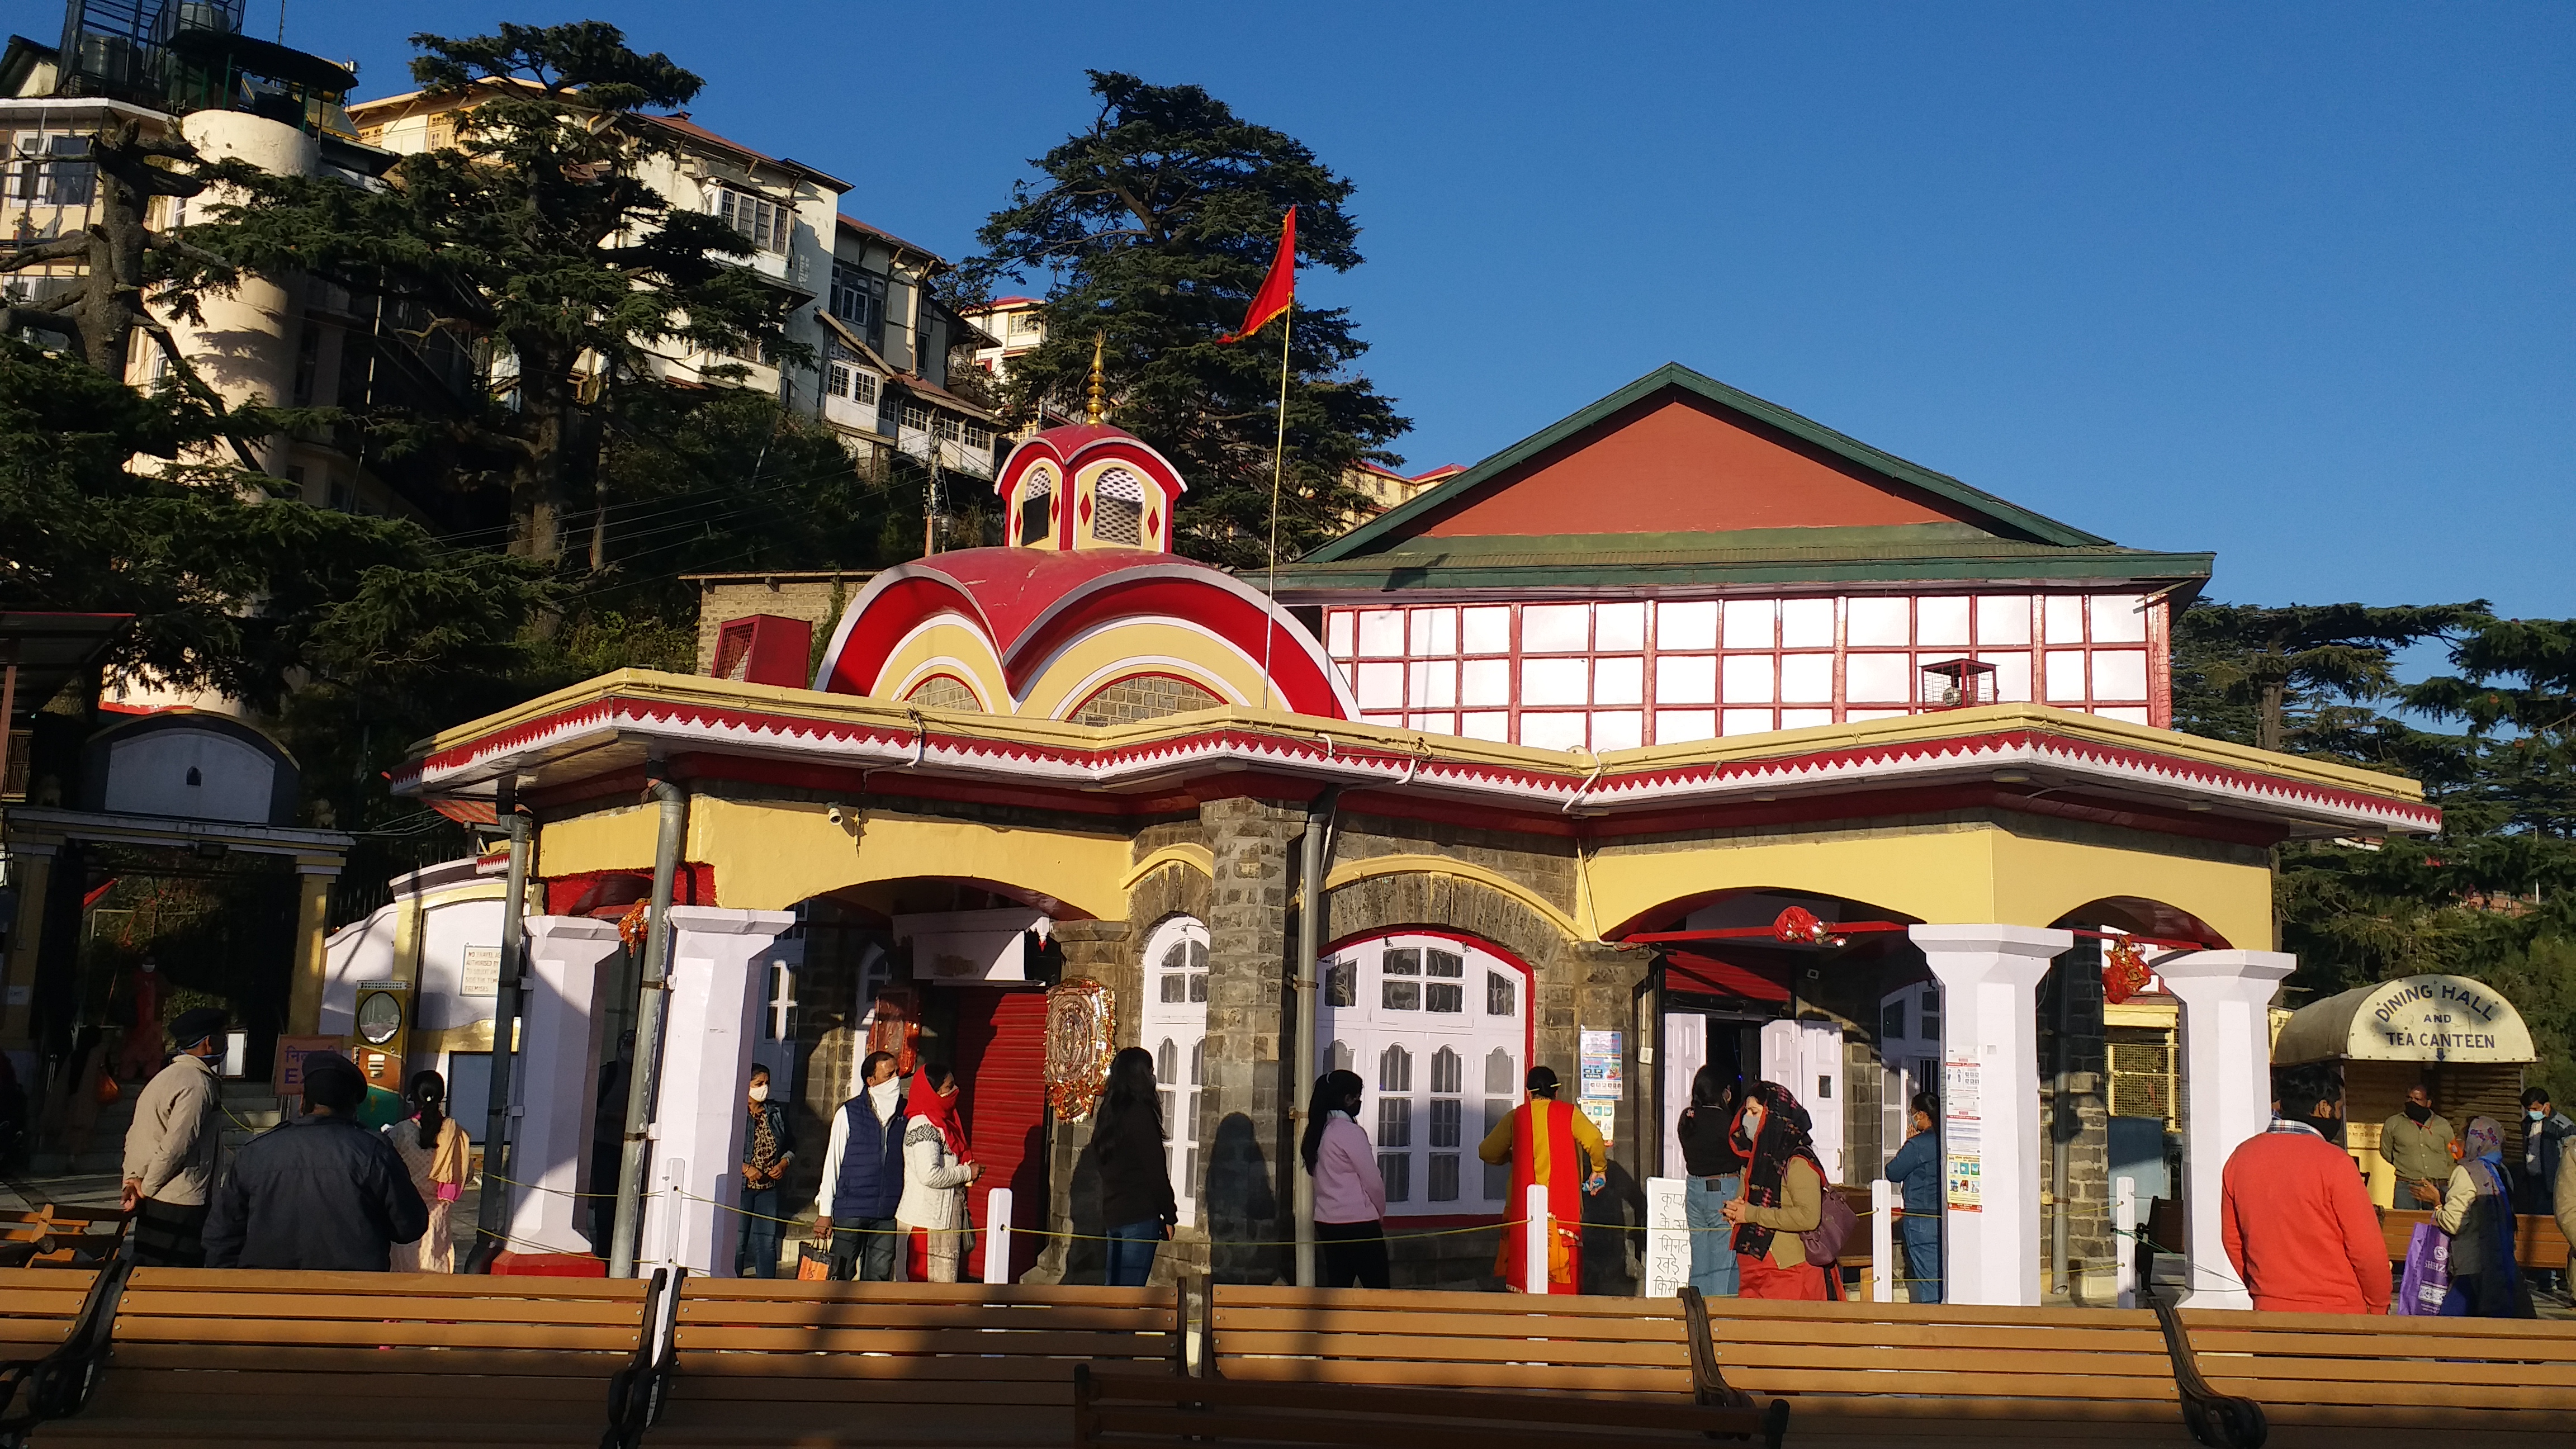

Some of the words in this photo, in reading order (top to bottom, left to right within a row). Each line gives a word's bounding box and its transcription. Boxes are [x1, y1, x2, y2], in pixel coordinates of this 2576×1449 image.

[2375, 985, 2432, 1022] DINING
[2442, 985, 2492, 1021] HALL
[2423, 1014, 2451, 1023] AND
[2386, 1033, 2414, 1046] TEA
[2419, 1034, 2495, 1048] CANTEEN
[1658, 1234, 1689, 1253] मिनट
[1654, 1276, 1679, 1297] किसी
